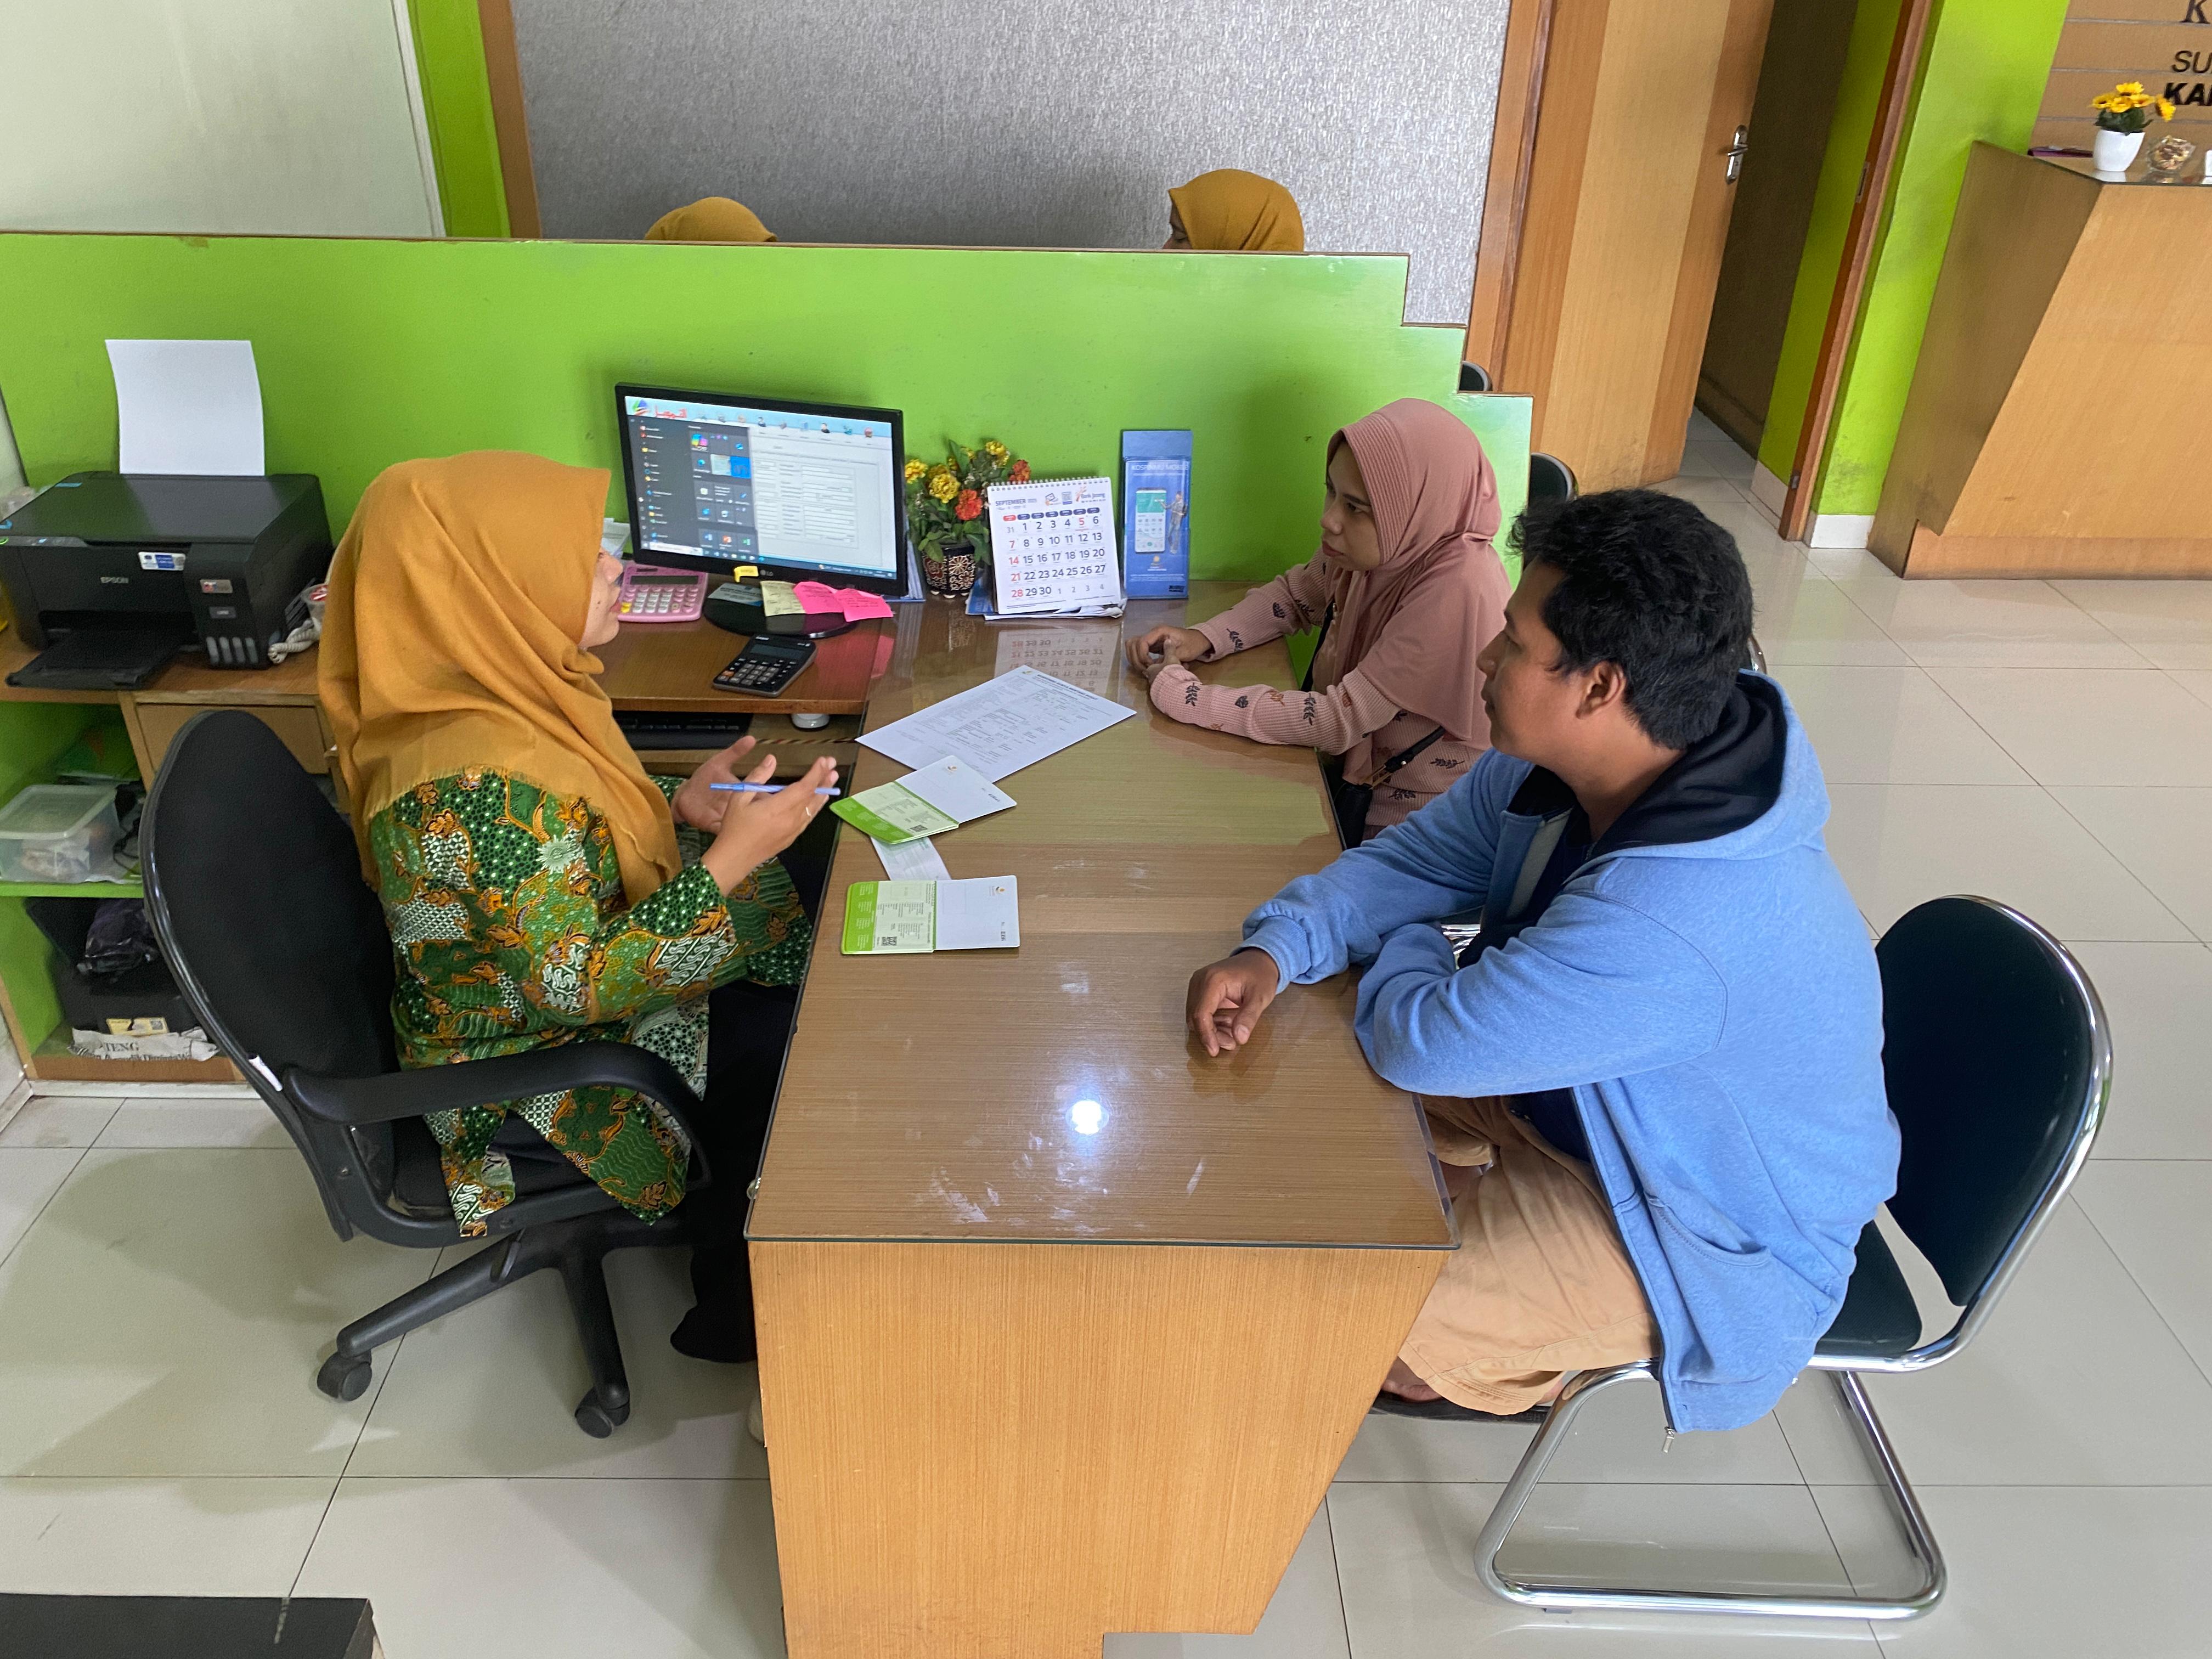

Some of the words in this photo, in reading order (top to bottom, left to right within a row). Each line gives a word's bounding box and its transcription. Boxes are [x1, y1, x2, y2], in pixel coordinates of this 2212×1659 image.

[2171, 50, 2212, 74] SU
[2164, 82, 2212, 106] KA
[995, 498, 1026, 506] SEPTEMBER
[1052, 569, 1064, 577] 24
[1040, 586, 1051, 595] 30
